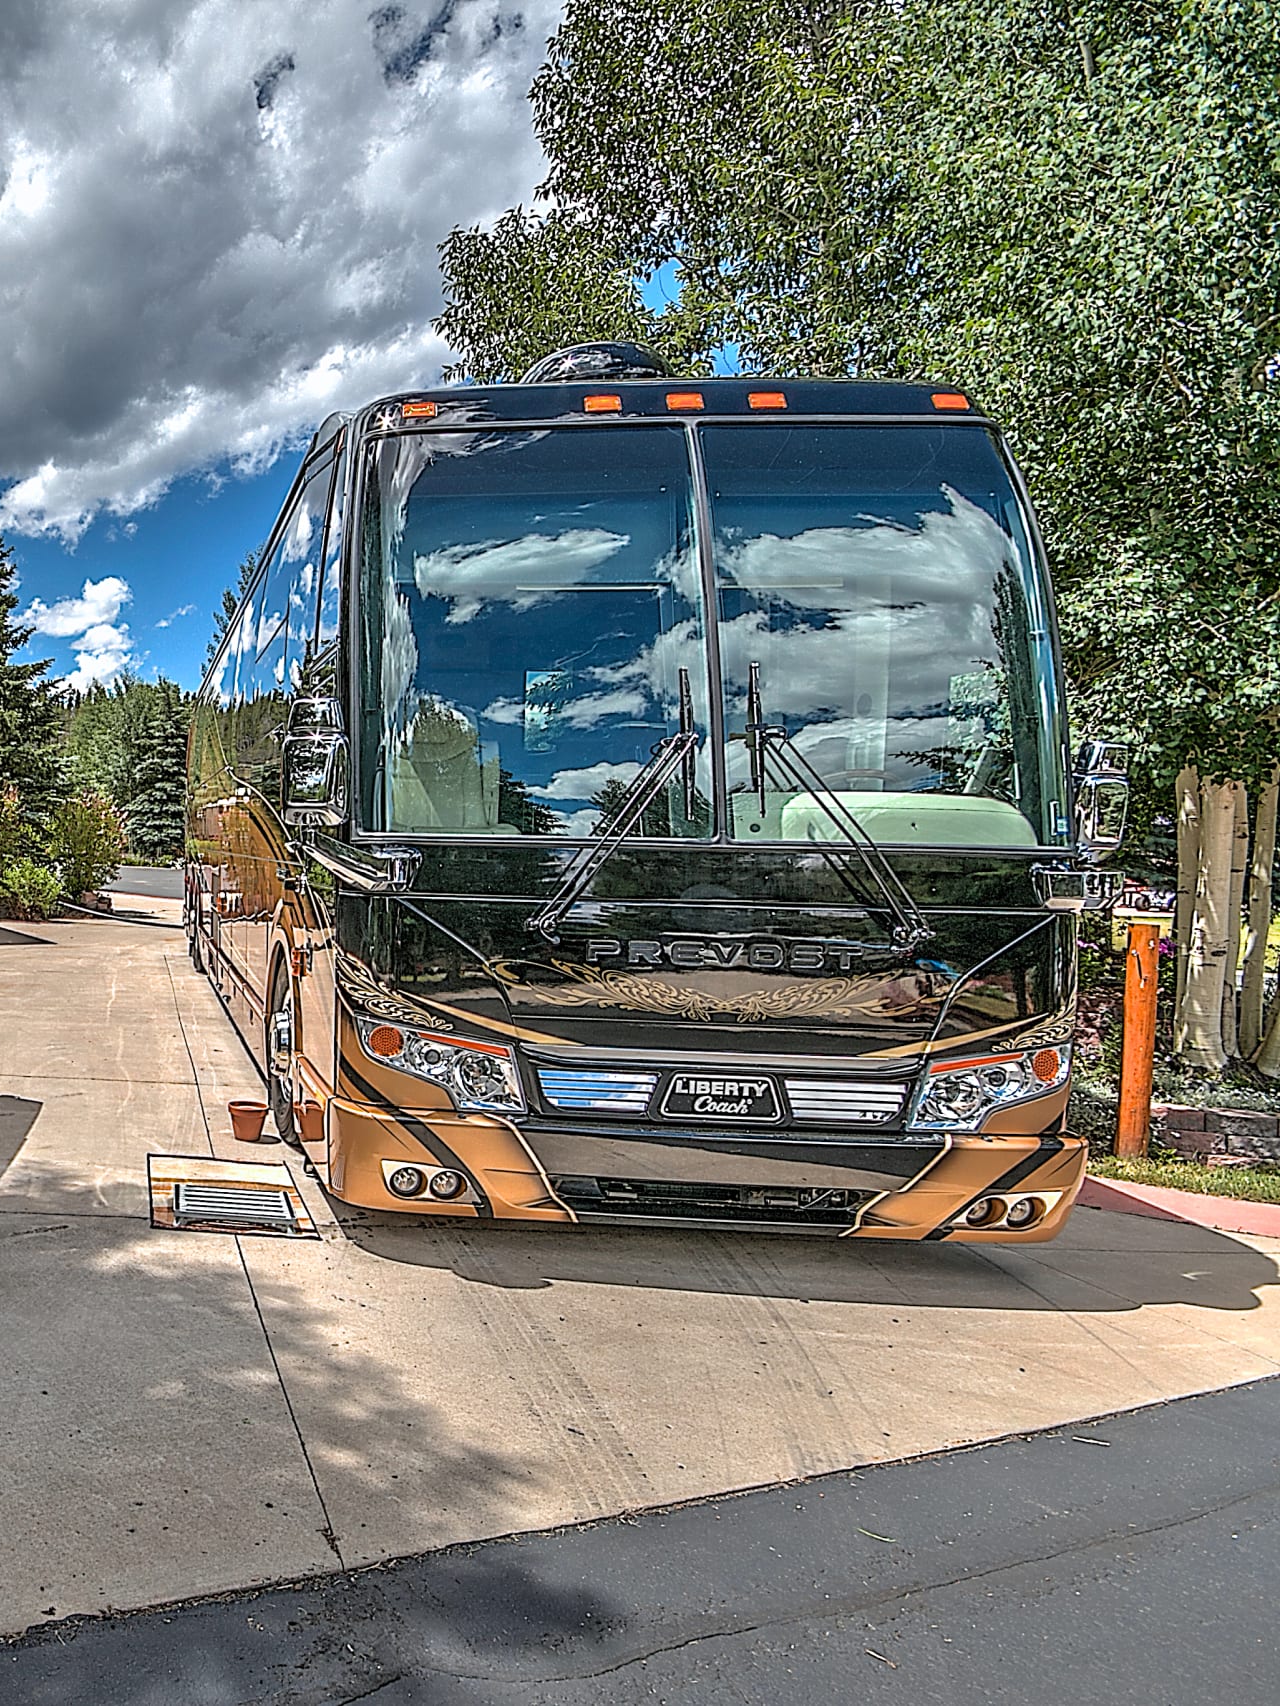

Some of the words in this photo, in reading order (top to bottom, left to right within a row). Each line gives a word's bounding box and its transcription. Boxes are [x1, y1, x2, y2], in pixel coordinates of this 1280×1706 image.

[585, 939, 863, 969] PREVOST
[675, 1080, 768, 1097] LIBERTY
[694, 1096, 748, 1114] Coach
